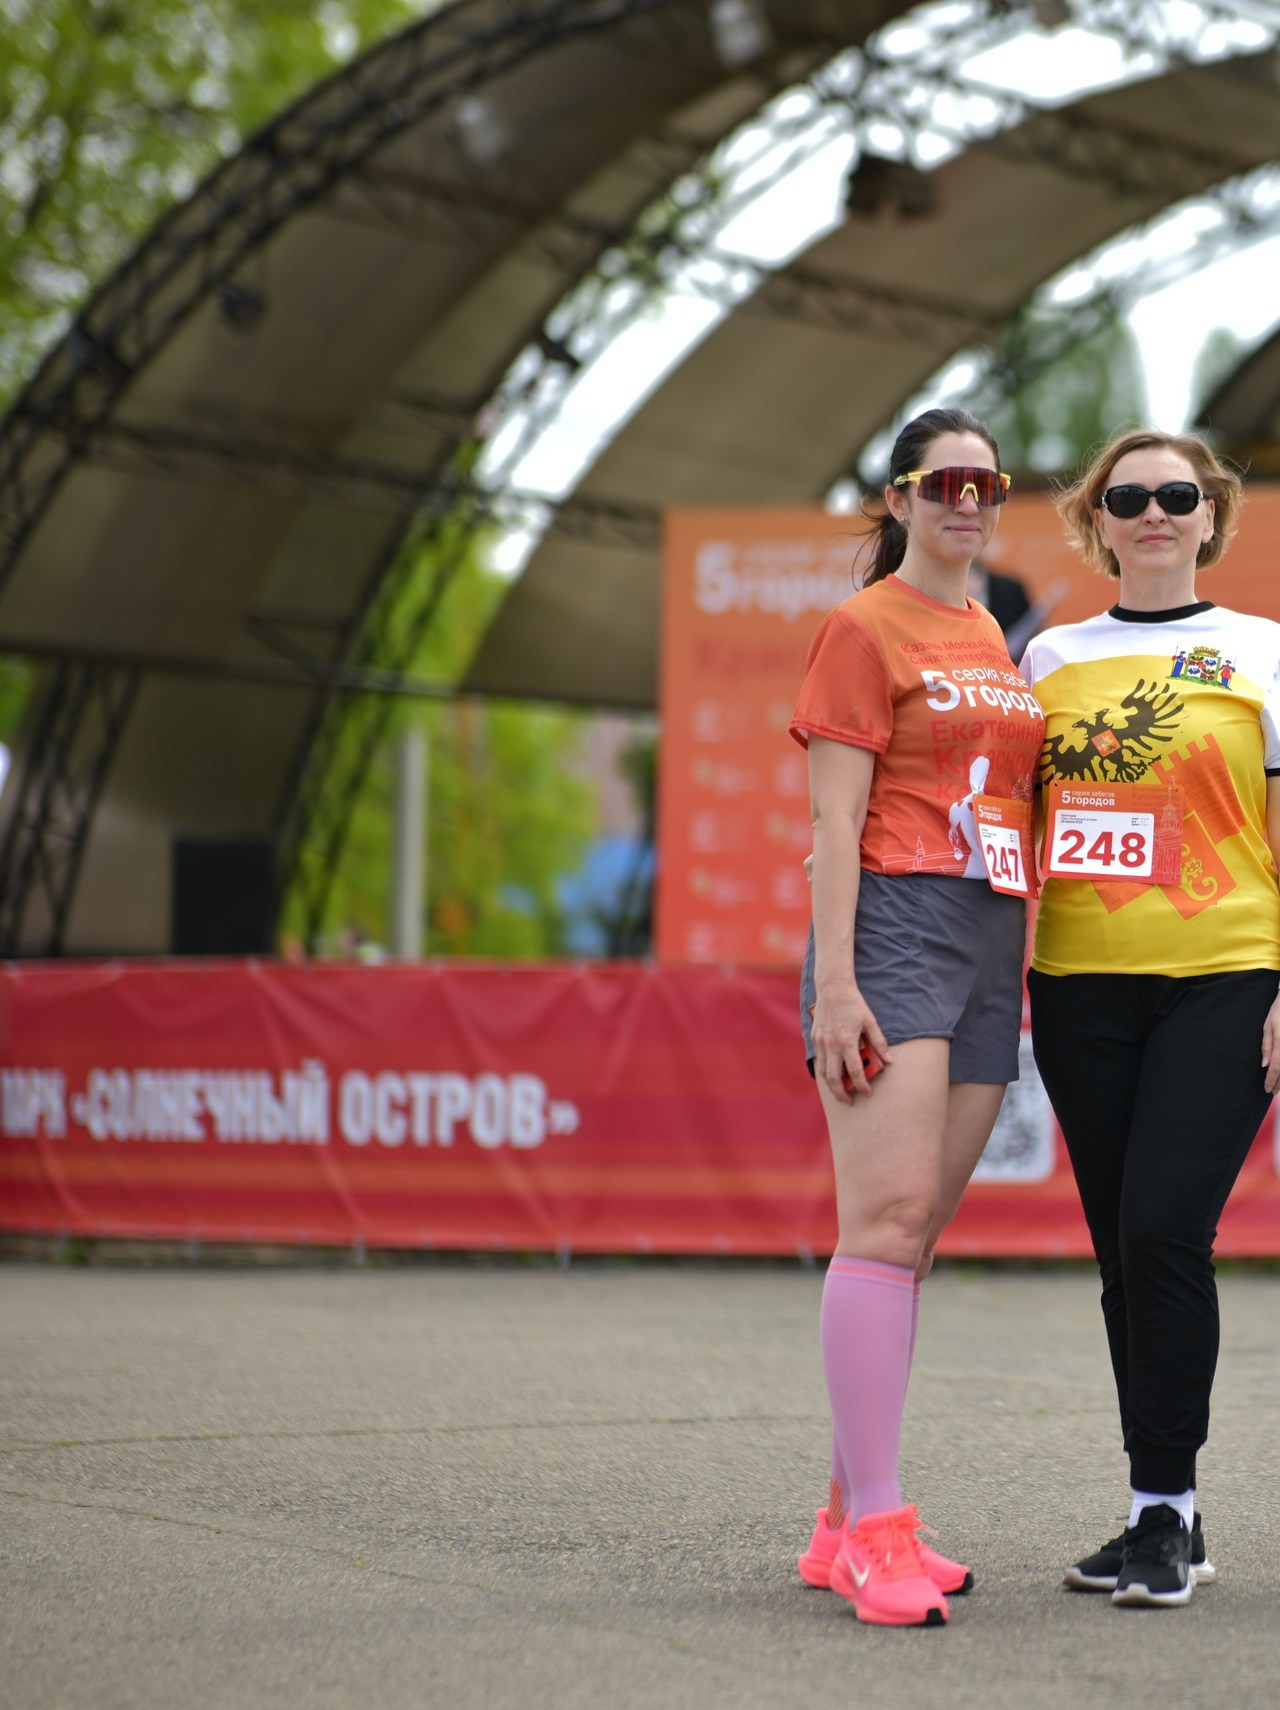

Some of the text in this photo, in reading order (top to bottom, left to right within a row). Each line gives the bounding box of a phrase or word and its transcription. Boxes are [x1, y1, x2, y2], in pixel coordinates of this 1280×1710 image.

[943, 639, 986, 651] Москва
[952, 667, 1001, 683] серия
[1000, 671, 1029, 688] забе
[962, 685, 1045, 720] город
[930, 719, 1045, 744] Екатеринб
[1072, 795, 1115, 806] городов
[986, 844, 1019, 882] 247
[1058, 829, 1146, 868] 248
[340, 1070, 581, 1150] ОСТРОВ»
